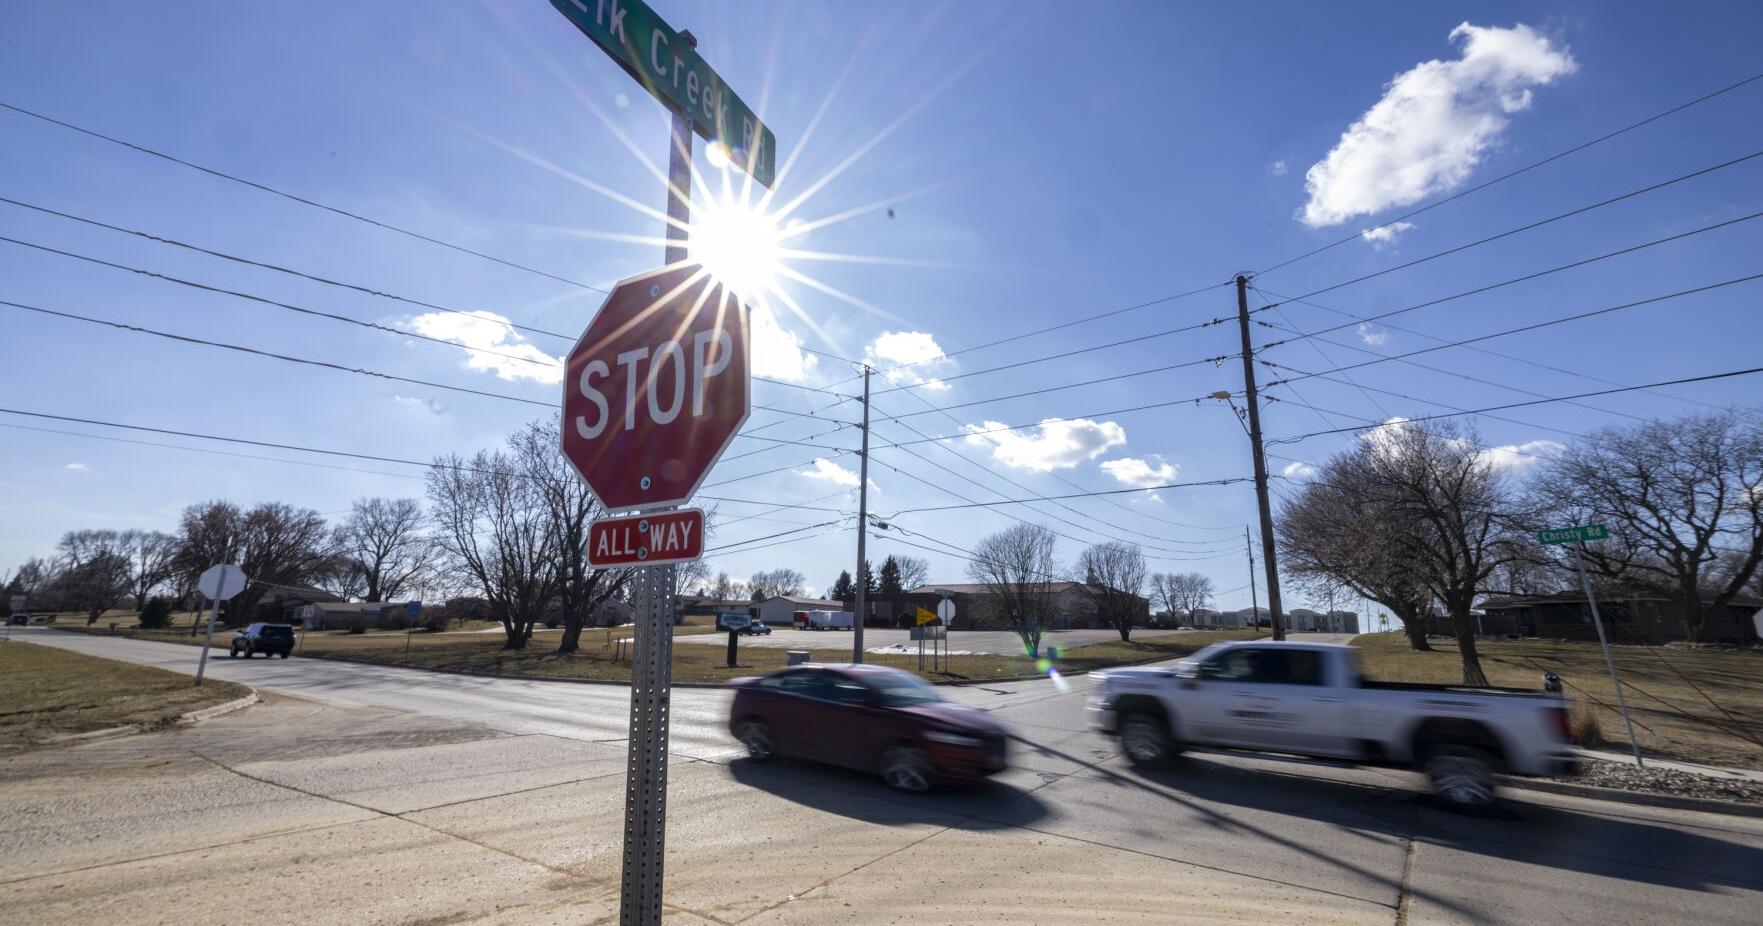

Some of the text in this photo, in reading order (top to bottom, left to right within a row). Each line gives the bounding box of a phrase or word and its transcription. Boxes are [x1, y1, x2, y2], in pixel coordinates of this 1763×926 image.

[570, 0, 765, 171] lk Creek Rd
[576, 328, 732, 440] STOP
[597, 520, 693, 557] ALL WAY
[1586, 526, 1602, 537] Rd
